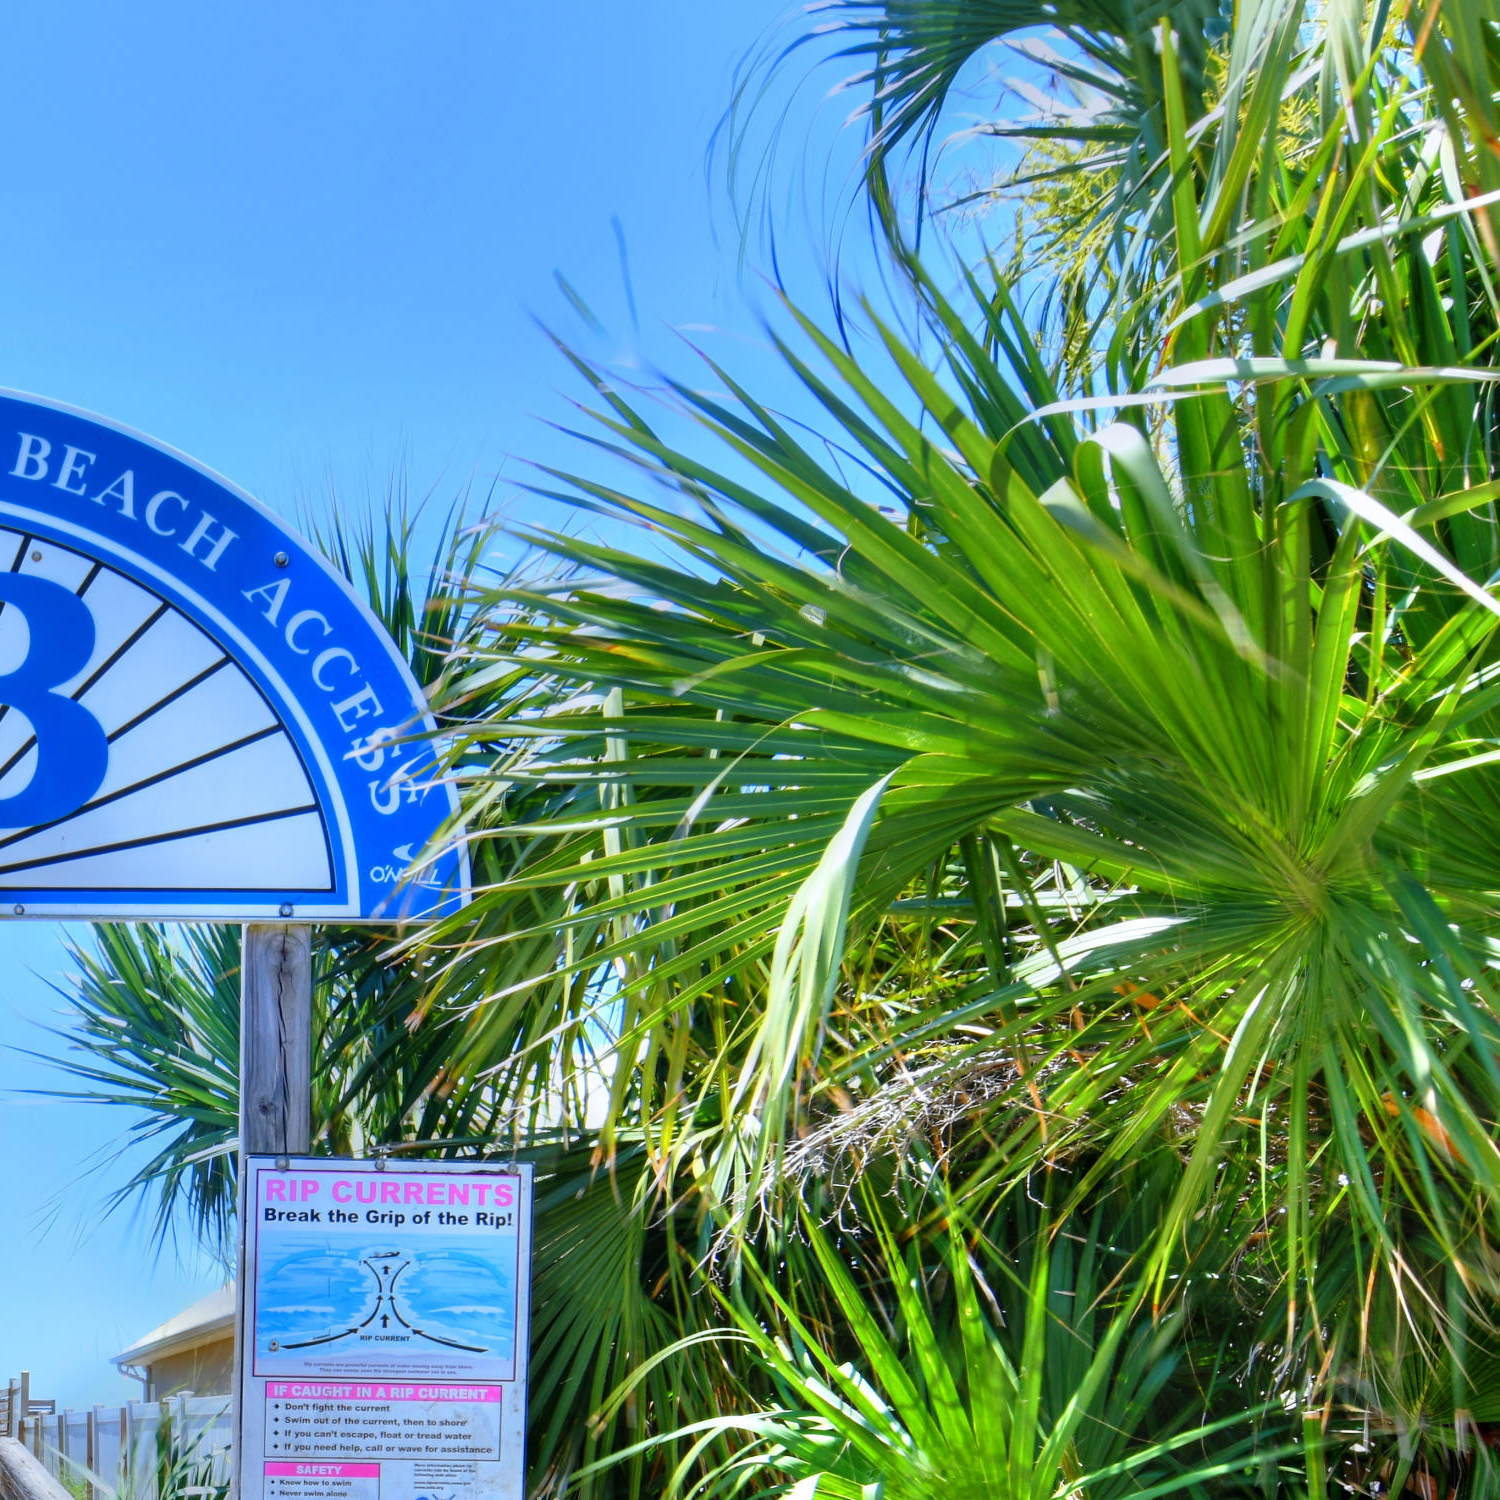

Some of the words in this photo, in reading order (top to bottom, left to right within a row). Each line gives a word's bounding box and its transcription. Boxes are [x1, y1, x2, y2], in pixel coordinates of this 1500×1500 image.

[9, 432, 239, 572] BEACH
[241, 577, 420, 815] ACCESS
[370, 865, 442, 885] O'NILL
[266, 1179, 320, 1202] RIP
[332, 1181, 514, 1207] CURRENTS
[264, 1207, 321, 1222] Break
[328, 1209, 358, 1223] the
[366, 1210, 405, 1227] Grip
[412, 1211, 430, 1225] of
[438, 1212, 468, 1226] the
[476, 1212, 512, 1229] Rip!
[274, 1385, 288, 1397] IF
[291, 1385, 352, 1399] CAUGHT
[354, 1386, 372, 1399] IN
[375, 1386, 386, 1399] A
[390, 1387, 414, 1399] RIP
[418, 1387, 488, 1400] CURRENT
[284, 1402, 309, 1413] Don't
[312, 1403, 334, 1413] fight
[336, 1403, 352, 1414] the
[354, 1403, 390, 1414] current
[284, 1416, 310, 1426] Swim
[313, 1416, 329, 1426] out
[331, 1417, 341, 1427] of
[344, 1417, 360, 1427] the
[362, 1417, 400, 1427] current,
[403, 1417, 424, 1428] then
[426, 1418, 436, 1428] to
[439, 1418, 465, 1428] shore
[284, 1429, 291, 1440] If
[294, 1429, 311, 1440] you
[314, 1429, 337, 1441] can't
[340, 1430, 377, 1441] escape,
[380, 1431, 401, 1441] float
[404, 1431, 414, 1441] or
[416, 1431, 442, 1442] tread
[444, 1432, 472, 1442] water
[284, 1442, 291, 1453] If
[293, 1442, 311, 1453] you
[313, 1442, 337, 1454] need
[339, 1443, 362, 1454] help,
[365, 1443, 382, 1454] call
[385, 1443, 395, 1455] or
[397, 1444, 422, 1455] wave
[424, 1444, 438, 1455] for
[440, 1444, 492, 1456] assistance
[296, 1464, 342, 1476] SAFETY
[279, 1478, 301, 1487] Know
[303, 1478, 320, 1488] how
[321, 1479, 329, 1488] to
[332, 1479, 351, 1488] swim
[279, 1489, 302, 1498] Never
[304, 1489, 324, 1499] swim
[325, 1490, 347, 1499] alone
